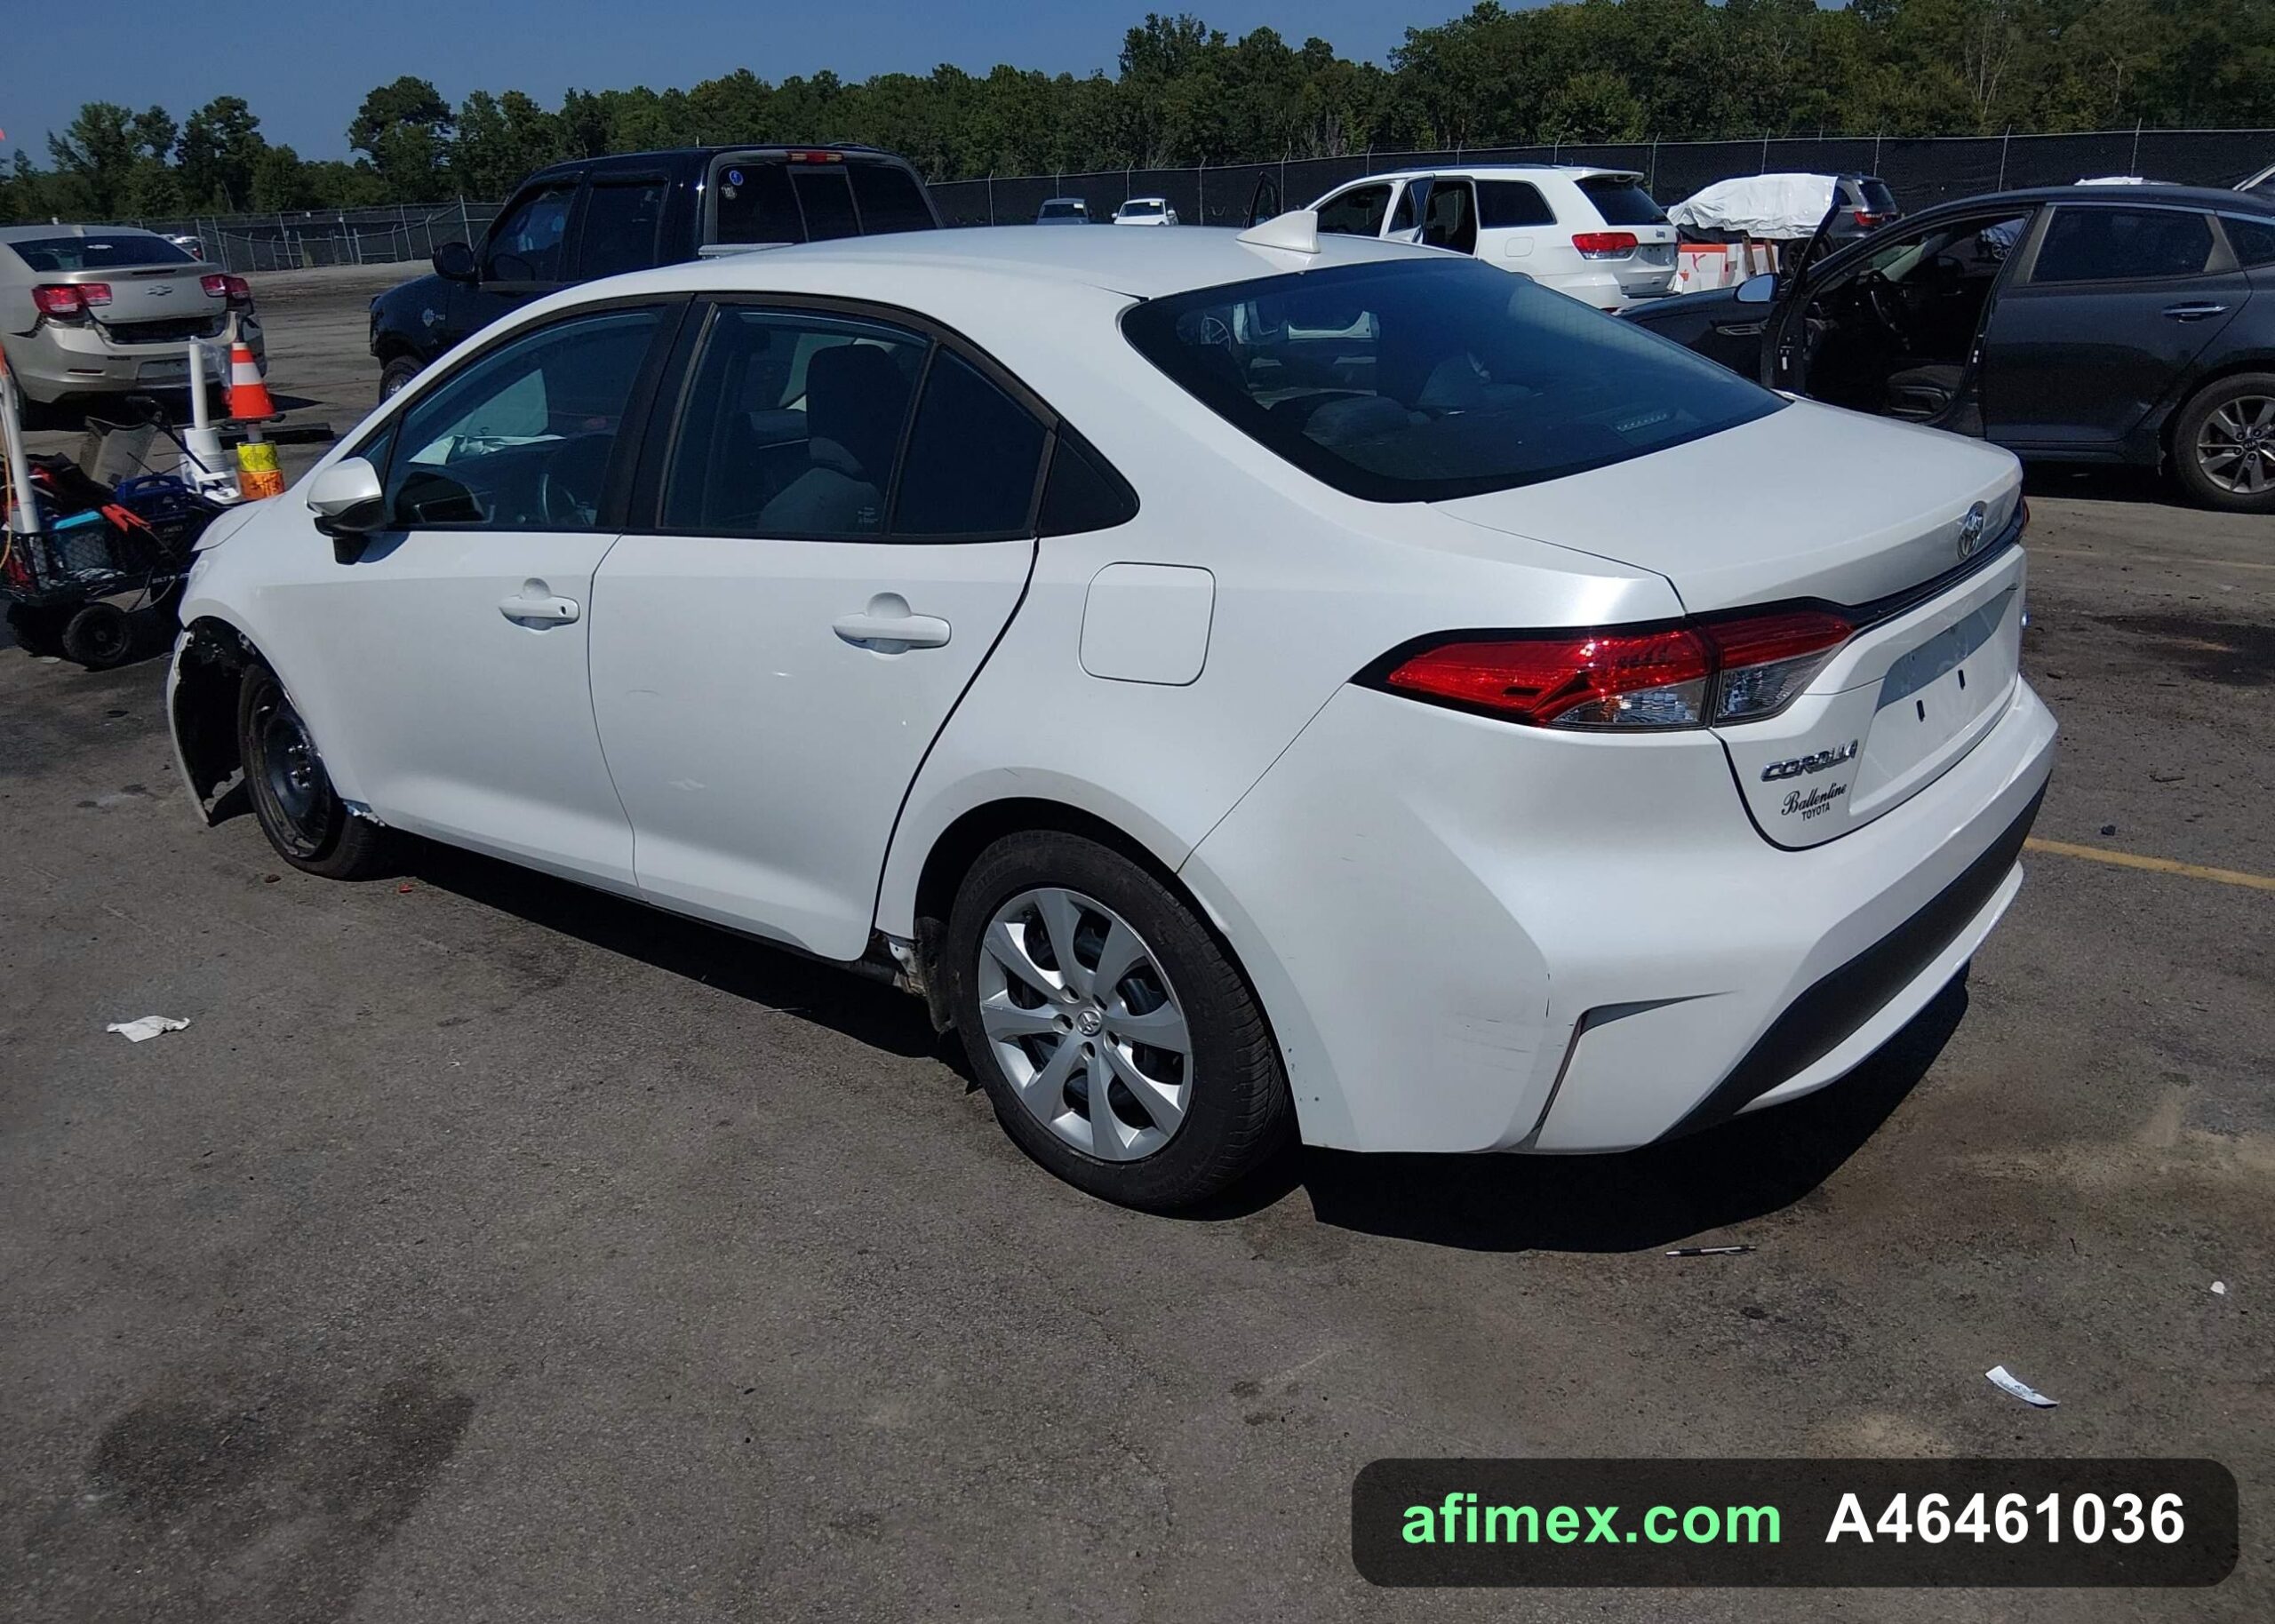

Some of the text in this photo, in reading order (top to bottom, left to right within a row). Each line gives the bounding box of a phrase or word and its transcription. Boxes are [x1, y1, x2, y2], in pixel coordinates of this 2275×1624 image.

[1760, 739, 1858, 782] COROLLA
[1781, 783, 1848, 816] Ballentine
[1802, 801, 1831, 821] TOYOTA
